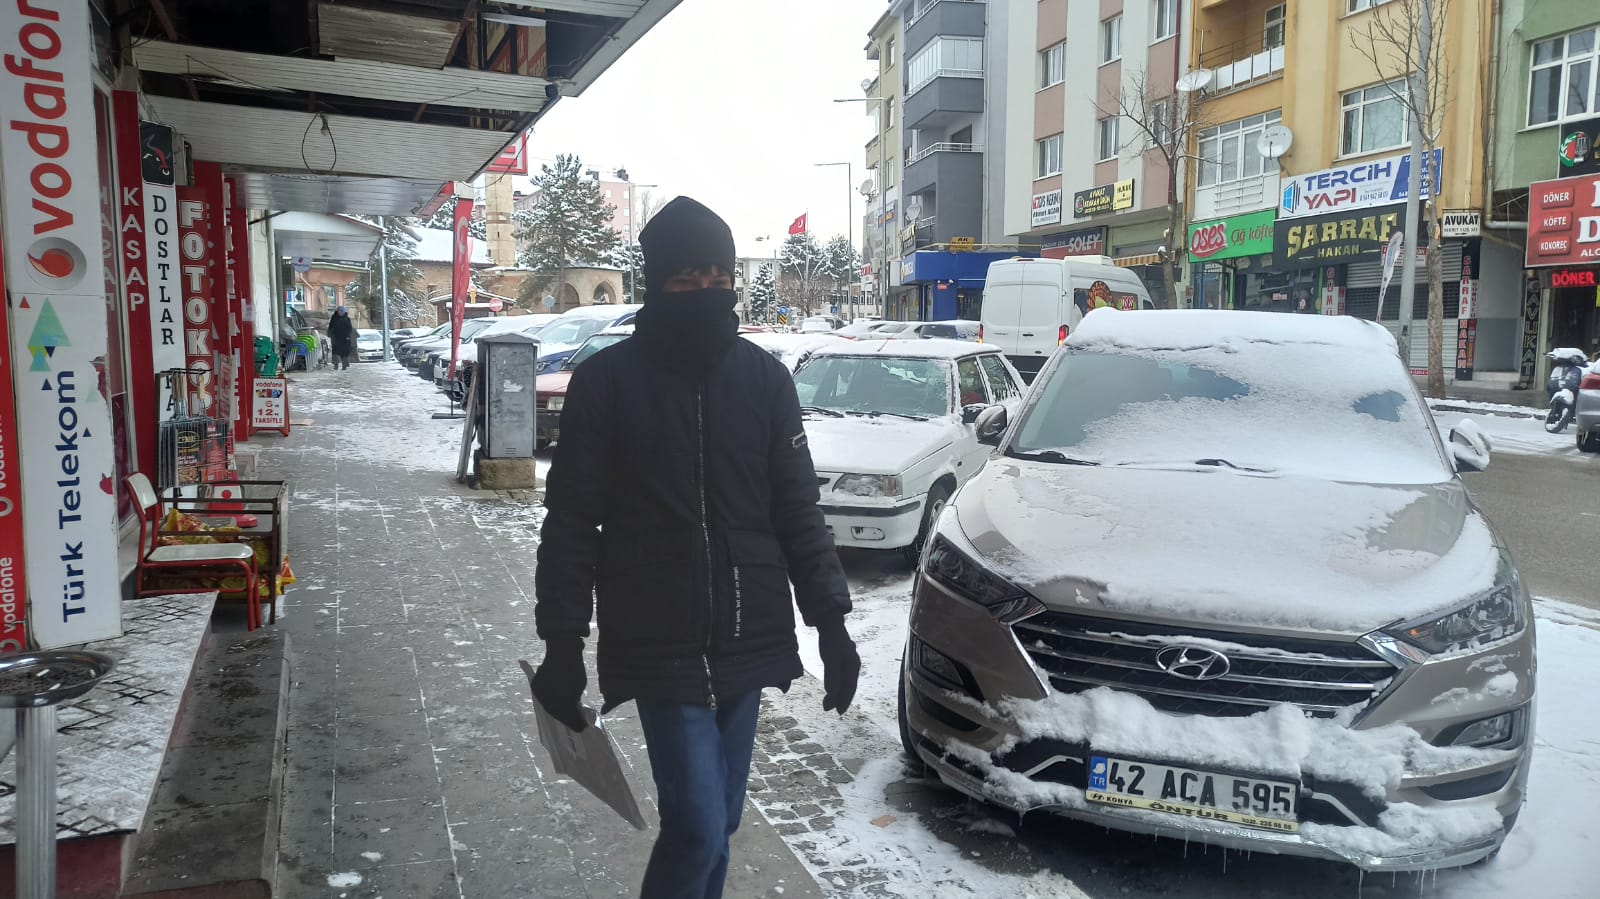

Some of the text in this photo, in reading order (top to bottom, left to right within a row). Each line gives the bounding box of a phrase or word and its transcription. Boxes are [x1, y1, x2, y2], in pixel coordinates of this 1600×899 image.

[1304, 161, 1392, 191] TERCİH
[1304, 188, 1357, 209] YAPI
[1543, 191, 1570, 203] DÖNER
[1287, 212, 1398, 258] SARRAF
[1444, 214, 1479, 226] AVUKAT
[1543, 215, 1567, 227] KÖFTE
[122, 187, 146, 312] KASAP
[1318, 244, 1360, 258] HAKAN
[1540, 239, 1567, 252] KOKOREÇ
[152, 194, 175, 345] DOSTLAR
[1552, 270, 1596, 288] DÖNER
[1460, 255, 1471, 315] SARRAF
[1457, 319, 1469, 369] HAKAN
[1521, 293, 1540, 376] AVUKAT
[55, 370, 86, 623] Türk Telekom
[0, 557, 16, 632] vodafone
[1092, 776, 1106, 787] TR
[1108, 761, 1291, 814] 42 ACA 595
[1106, 796, 1133, 806] KONYA
